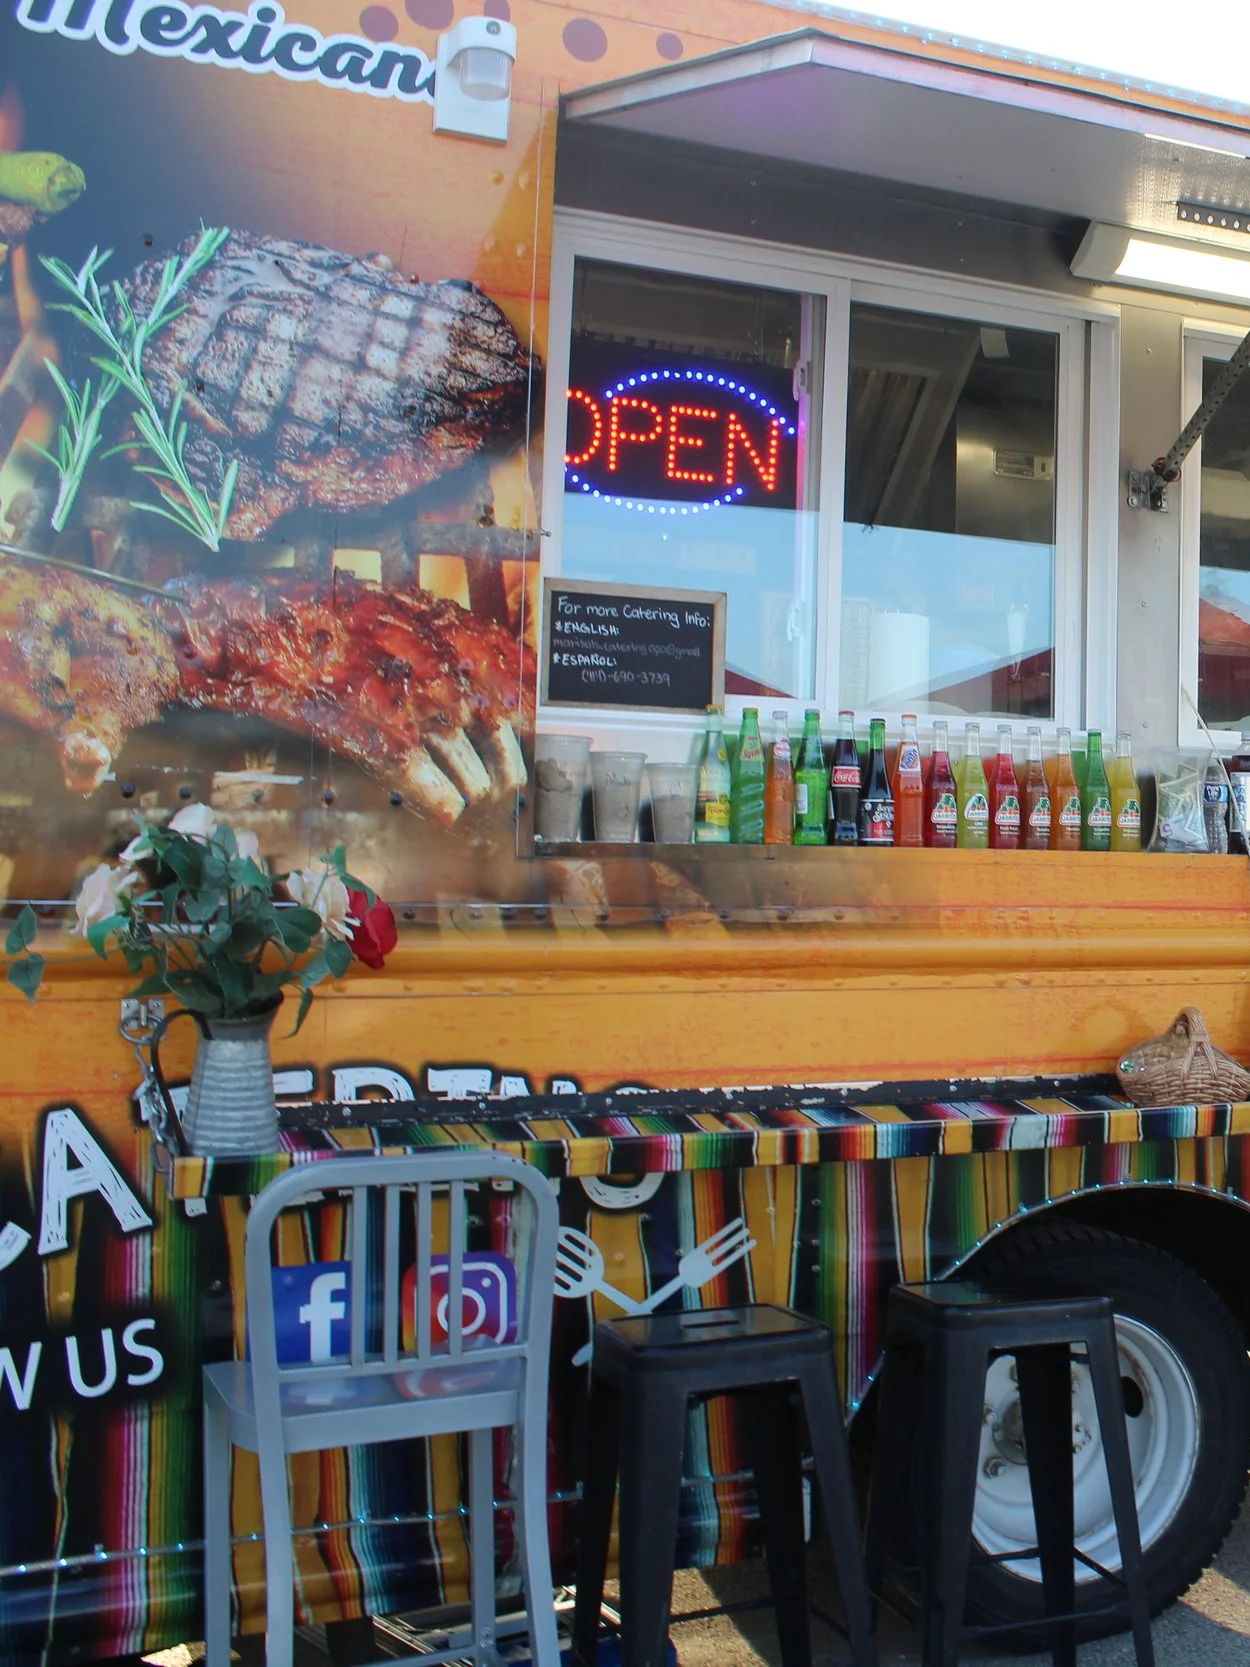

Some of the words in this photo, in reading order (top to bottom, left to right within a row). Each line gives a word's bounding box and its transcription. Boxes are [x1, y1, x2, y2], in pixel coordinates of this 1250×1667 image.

[27, 0, 437, 98] Mexican
[564, 388, 781, 491] OPEN
[558, 595, 580, 616] For
[586, 604, 619, 617] more
[622, 603, 681, 629] Catering
[900, 748, 918, 770] Fanta
[65, 1318, 165, 1398] US
